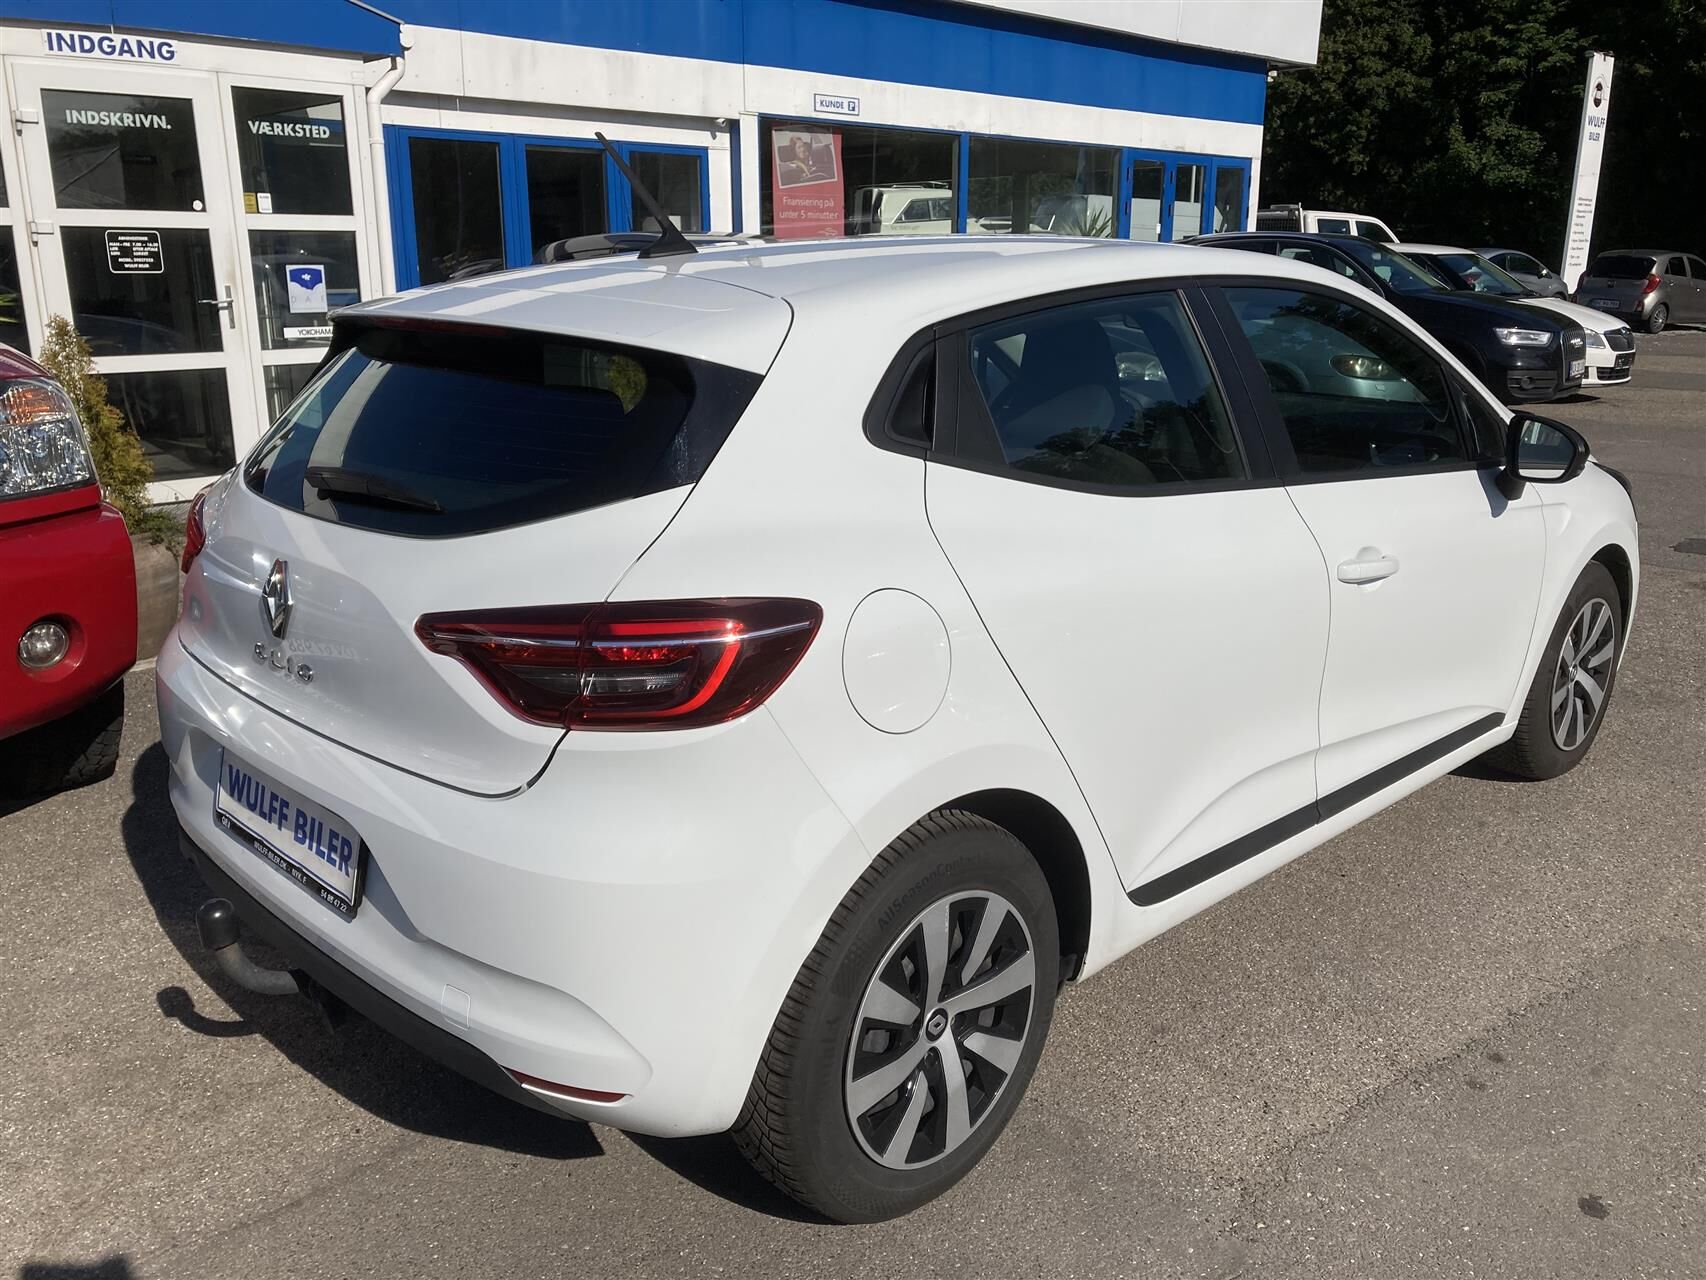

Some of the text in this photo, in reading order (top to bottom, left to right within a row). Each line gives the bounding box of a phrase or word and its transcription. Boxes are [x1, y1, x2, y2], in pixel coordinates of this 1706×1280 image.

[45, 31, 176, 61] INDGANG
[819, 99, 844, 110] KUNDE
[65, 109, 172, 130] INDSKRIVN.
[1587, 115, 1605, 129] WULFF
[248, 120, 330, 139] VÆRKSTED
[824, 198, 834, 208] på
[800, 210, 807, 219] 5
[297, 327, 333, 337] YOKOHAM
[228, 764, 353, 878] WULFF BILER
[320, 889, 328, 899] 54
[339, 903, 348, 913] 22
